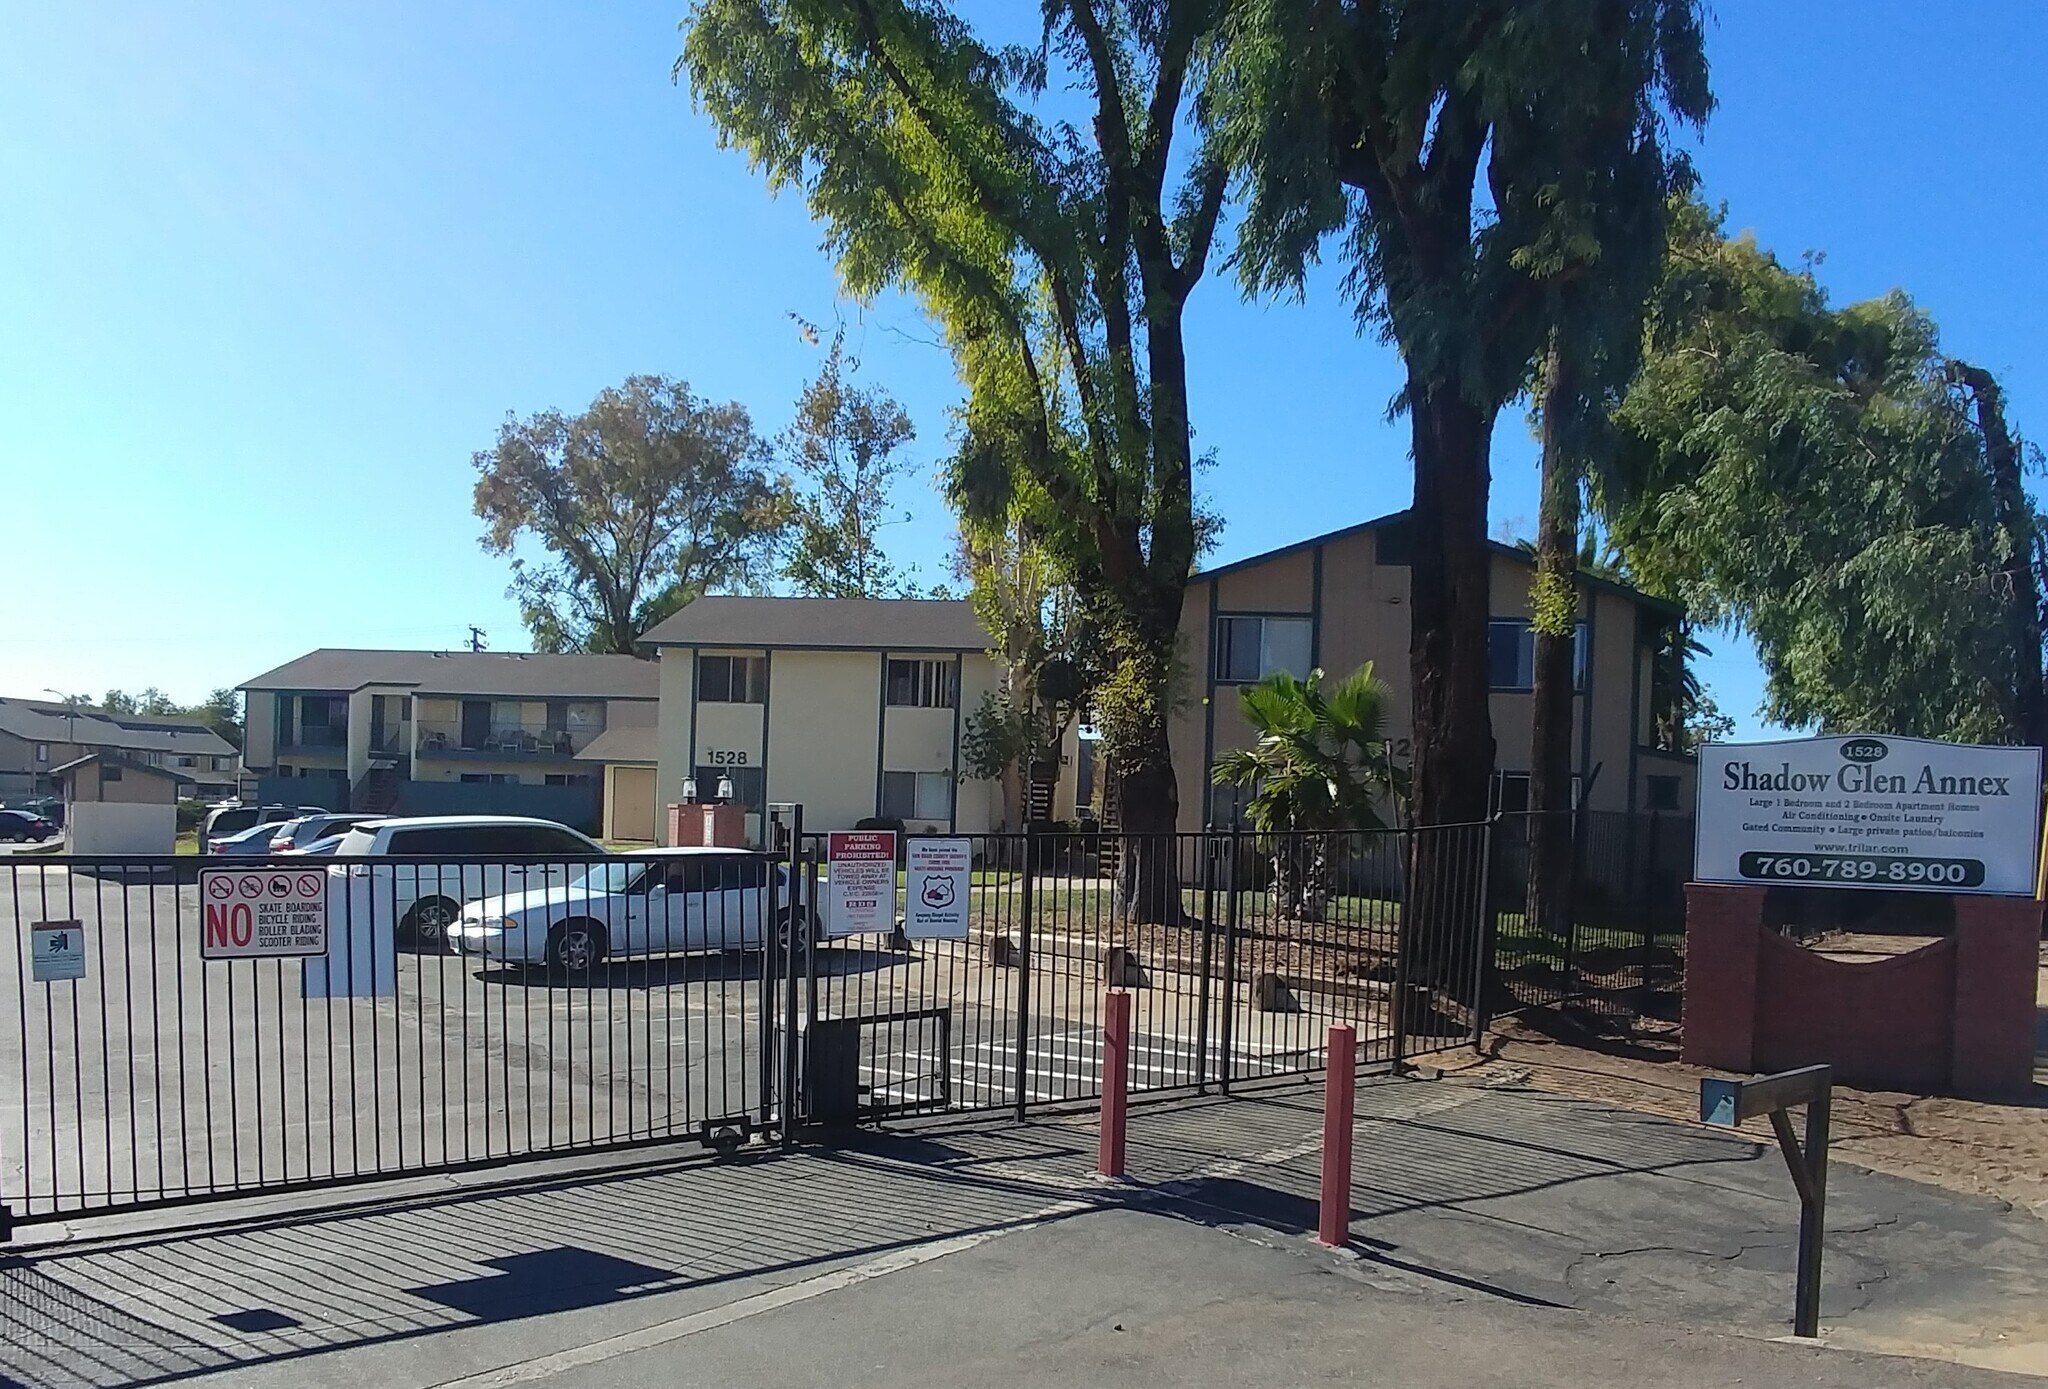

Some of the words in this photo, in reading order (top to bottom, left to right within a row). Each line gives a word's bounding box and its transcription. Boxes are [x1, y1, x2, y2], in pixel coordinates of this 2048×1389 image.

[707, 751, 748, 764] 1528
[1846, 746, 1882, 758] 1528
[1724, 762, 1830, 792] Shadow
[1837, 764, 1906, 794] Glen
[1912, 765, 2010, 796] Annex
[1749, 798, 1773, 808] Large
[1784, 798, 1822, 808] Bedroom
[1825, 800, 1842, 808] and
[1844, 800, 1850, 808] 2
[1853, 800, 1893, 810] Bedroom
[1895, 802, 1945, 812] Apartment
[1782, 811, 1796, 820] Air
[1798, 812, 1860, 822] Conditioning
[1869, 813, 1901, 822] Onsite
[1904, 814, 1944, 825] Laundry
[1742, 822, 1768, 832] Gated
[1772, 824, 1826, 834] Community
[1838, 826, 1864, 836] Large
[1866, 827, 1900, 836] private
[1756, 858, 1966, 883] 760-789-8900
[259, 903, 282, 913] SKATE
[286, 902, 322, 912] BOARDING
[206, 902, 252, 948] NO
[258, 914, 288, 924] BICYCLE
[292, 914, 316, 924] RIDING
[258, 926, 286, 936] ROLLER
[290, 925, 322, 935] BLADING
[258, 937, 292, 948] SCOOTER
[295, 936, 319, 946] RIDING
